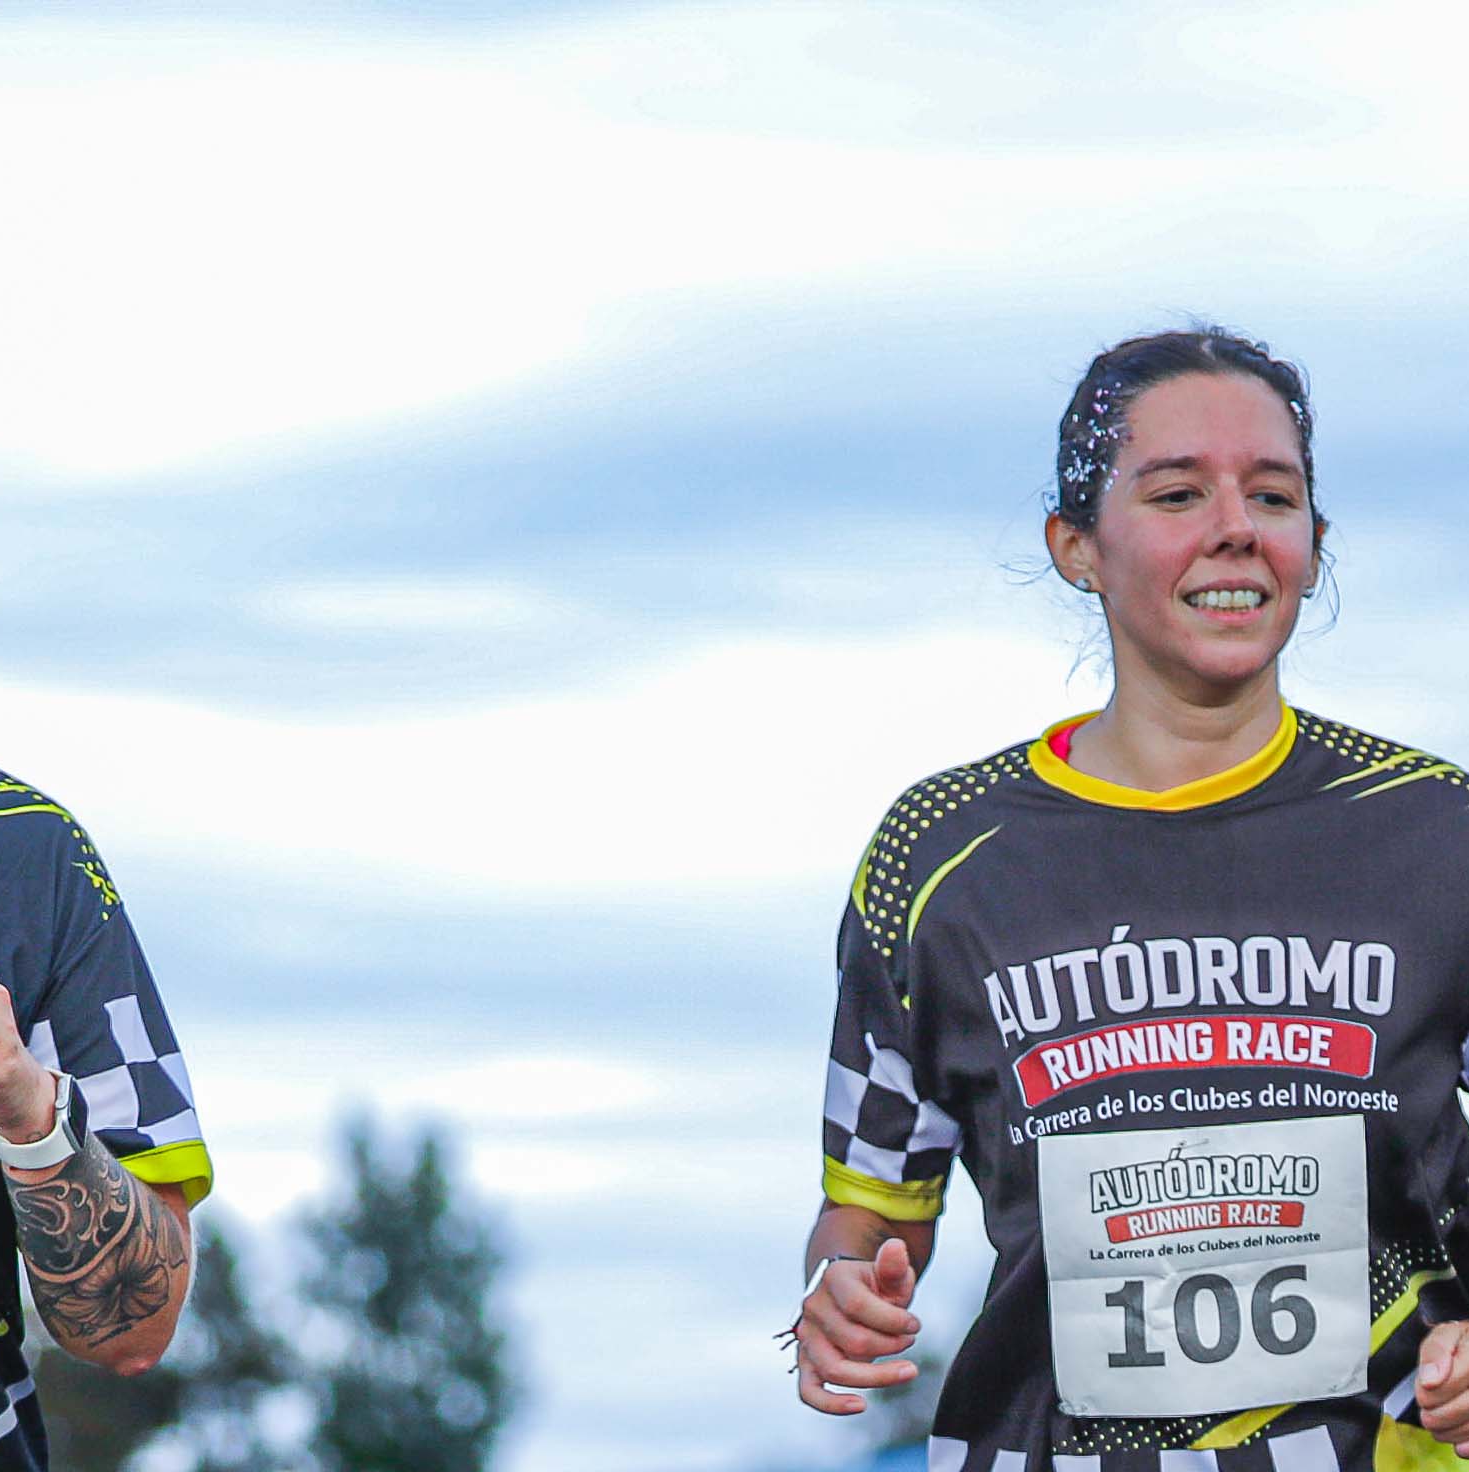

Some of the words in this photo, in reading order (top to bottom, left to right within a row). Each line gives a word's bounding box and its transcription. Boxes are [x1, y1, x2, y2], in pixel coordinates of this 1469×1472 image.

[981, 924, 1397, 1049] AUTÓDROMO
[1040, 1021, 1214, 1091] RUNNING
[1225, 1020, 1334, 1067] RACE
[1024, 1102, 1092, 1140] Carrera
[1096, 1097, 1124, 1119] de
[1129, 1089, 1165, 1113] los
[1169, 1084, 1253, 1112] Clubes
[1258, 1083, 1297, 1108] del
[1304, 1084, 1399, 1112] Noroeste
[1089, 1147, 1319, 1213] AUTÓDROMO
[1089, 1248, 1105, 1261] La
[1107, 1248, 1155, 1260] Carrera
[1158, 1244, 1173, 1256] de
[1177, 1242, 1195, 1254] los
[1197, 1240, 1241, 1253] Clubes
[1243, 1235, 1263, 1248] del
[1265, 1231, 1321, 1246] Noroeste
[1128, 1205, 1221, 1238] RUNNING
[1227, 1203, 1282, 1225] RACE
[1105, 1265, 1318, 1369] 106
